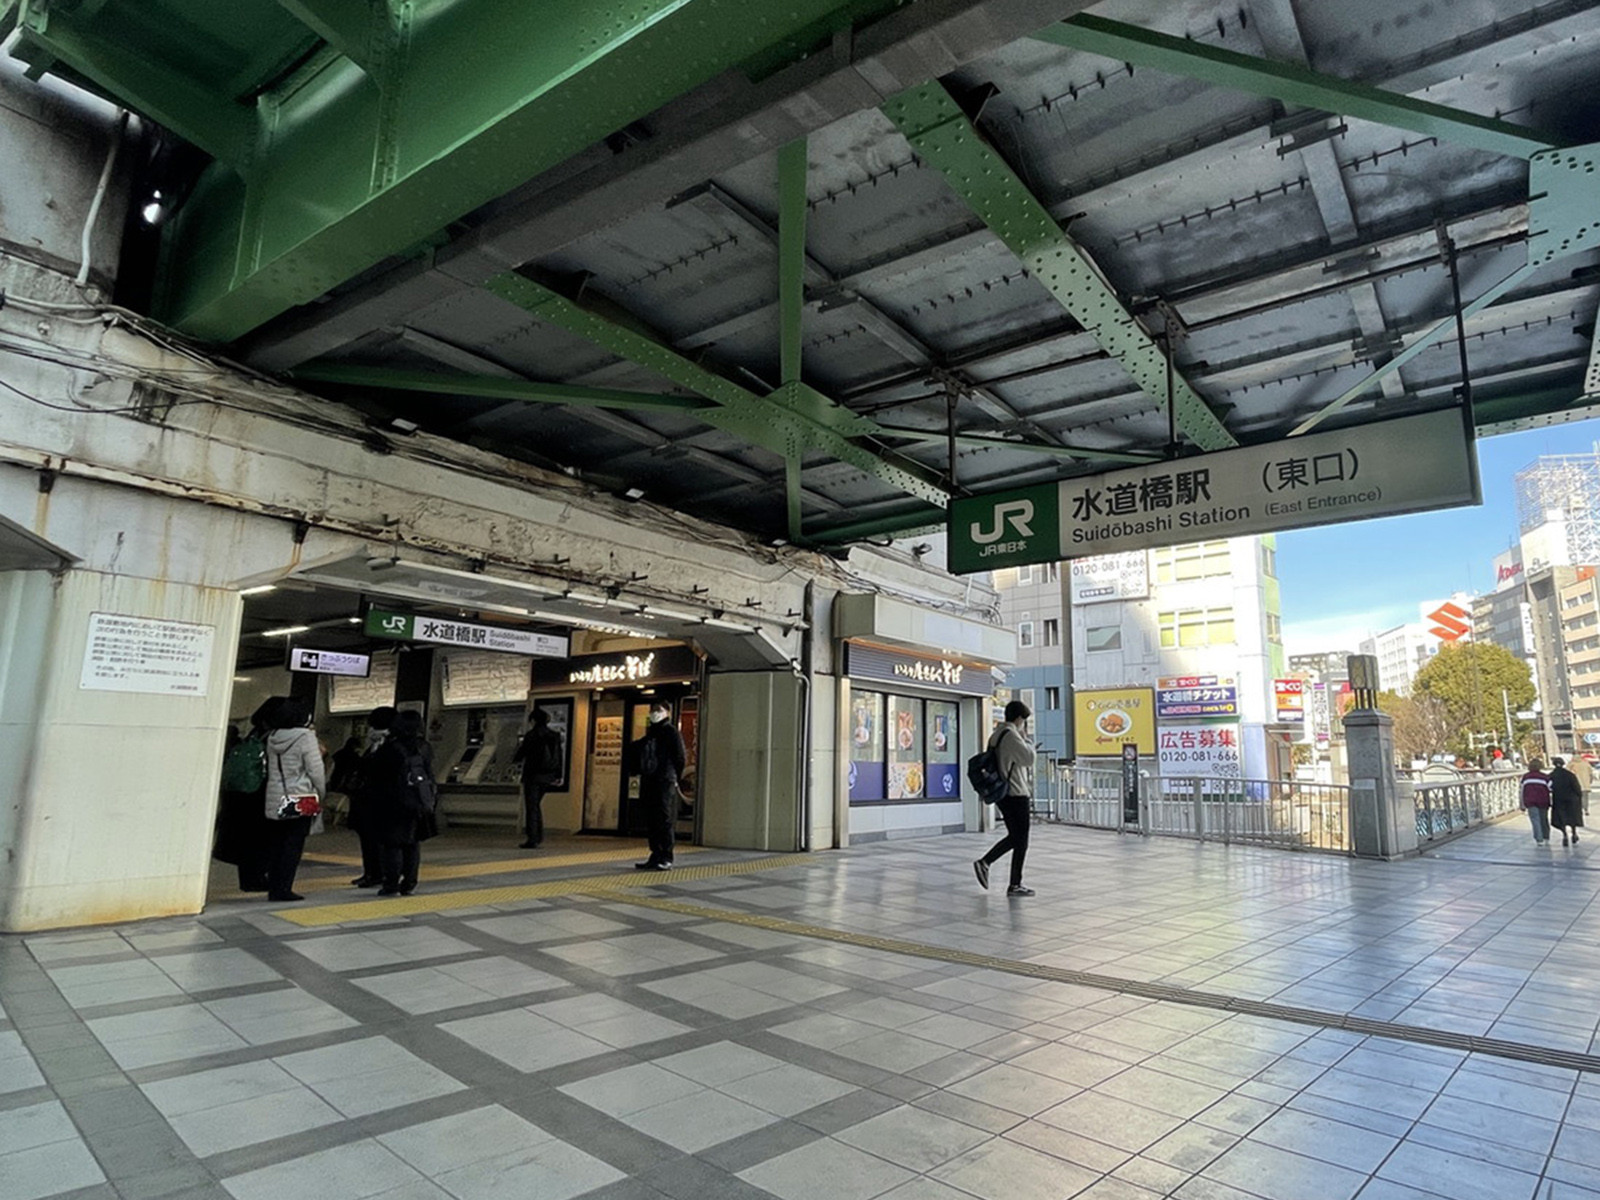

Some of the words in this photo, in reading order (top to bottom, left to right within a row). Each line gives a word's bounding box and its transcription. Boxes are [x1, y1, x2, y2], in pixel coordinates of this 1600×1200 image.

[1071, 468, 1212, 522] 水道橋駅
[971, 499, 1034, 543] JR
[1072, 514, 1173, 544] Suidōbashi
[1179, 505, 1250, 528] Station
[1265, 500, 1302, 516] (East
[1307, 486, 1382, 510] Entrance)
[979, 540, 1027, 557] JR東日本
[382, 616, 406, 630] JR
[423, 622, 486, 644] 水道橋駅
[1161, 729, 1237, 749] 広告募集
